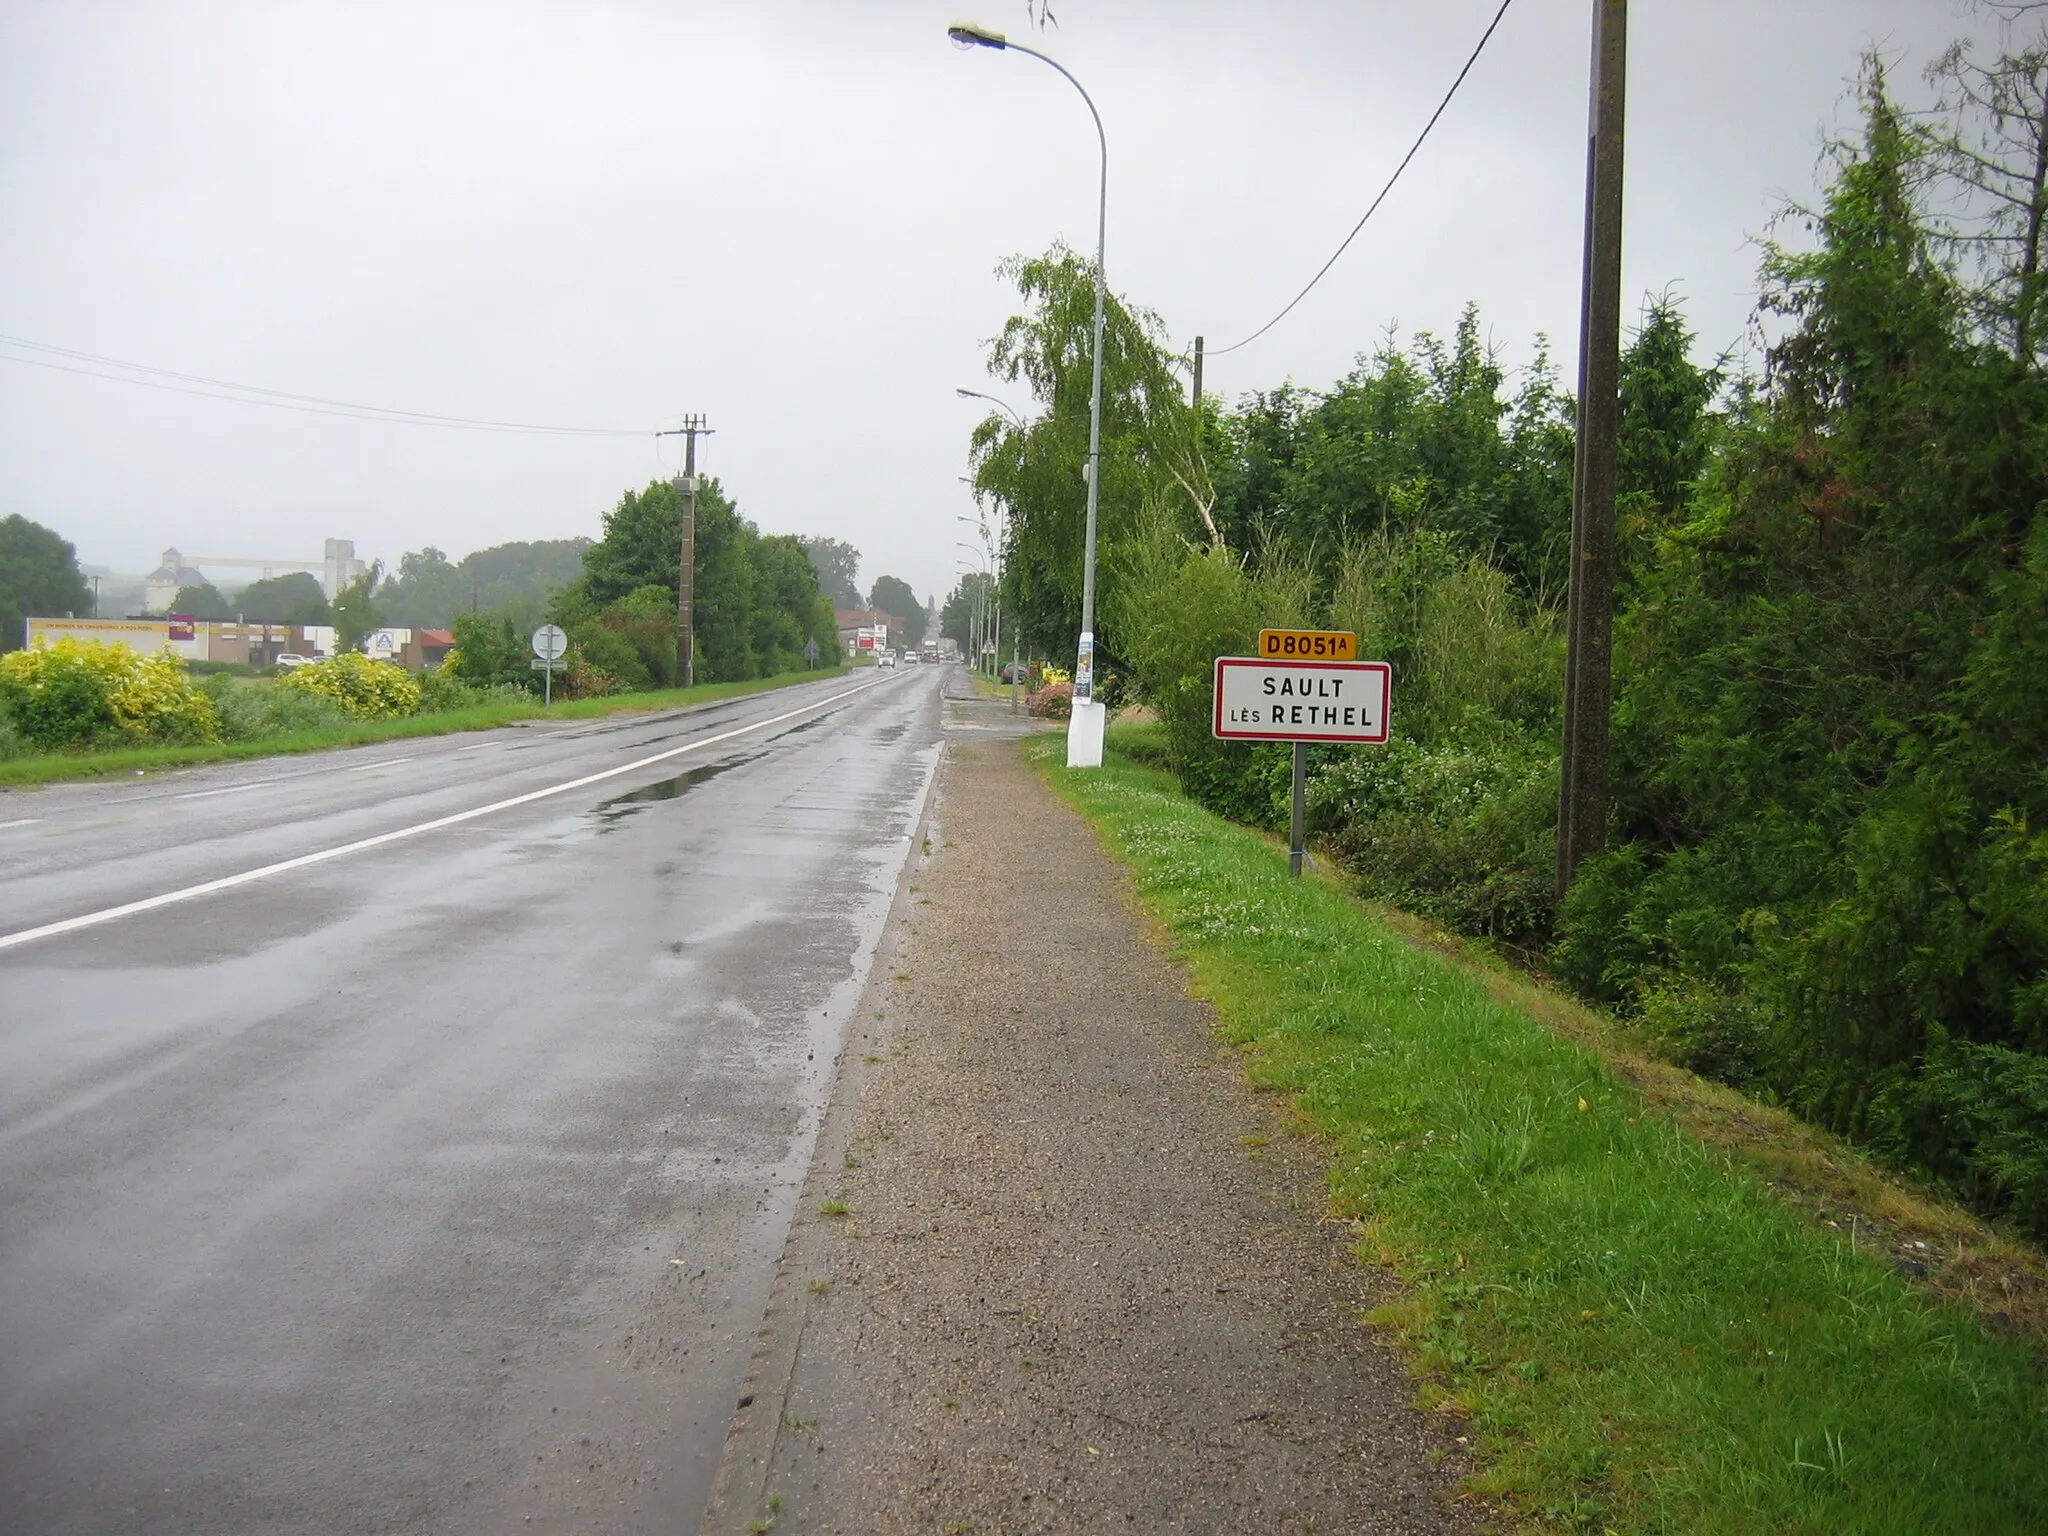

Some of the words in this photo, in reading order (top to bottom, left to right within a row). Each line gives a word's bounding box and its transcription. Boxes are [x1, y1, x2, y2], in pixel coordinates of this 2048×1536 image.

[1267, 635, 1347, 656] D8051A
[1263, 676, 1343, 697] SAULT
[1231, 707, 1260, 723] LÈS
[1271, 705, 1372, 726] RETHEL
